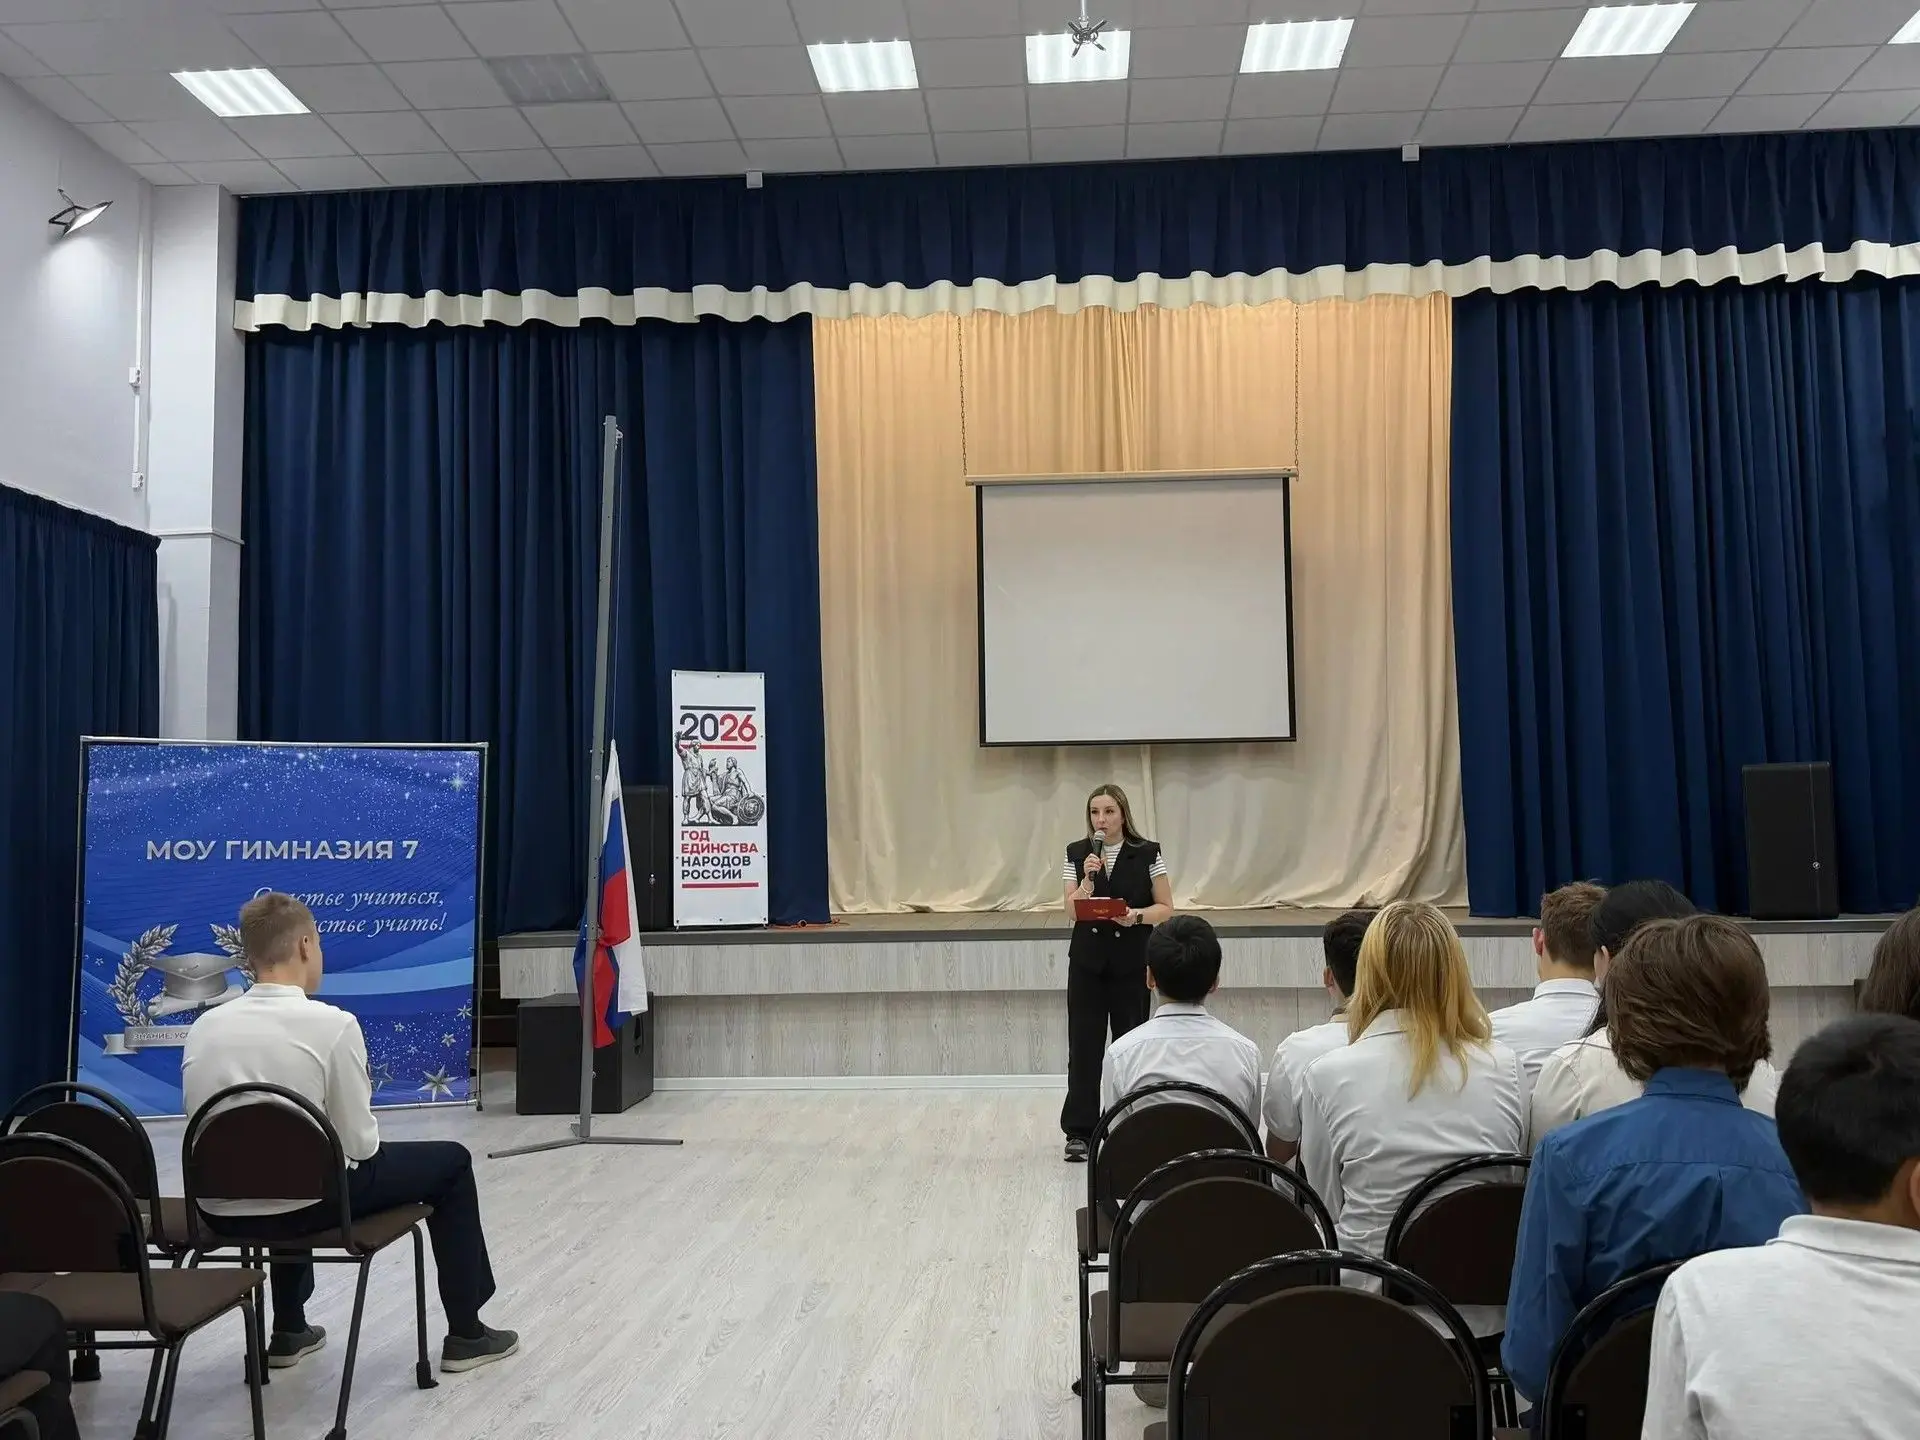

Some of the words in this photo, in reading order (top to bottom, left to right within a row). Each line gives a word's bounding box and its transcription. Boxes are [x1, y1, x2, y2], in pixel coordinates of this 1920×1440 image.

[679, 713, 756, 742] 2026
[681, 831, 710, 842] ГОД
[146, 840, 216, 860] МОУ
[225, 840, 393, 860] ГИМНАЗИЯ
[403, 840, 418, 859] 7
[681, 843, 759, 855] ЕДИНСТВА
[681, 855, 752, 868] НАРОДОВ
[681, 869, 743, 880] РОССИИ
[253, 886, 344, 906] Сстье
[346, 890, 445, 912] учиться,
[367, 911, 447, 938] учить!
